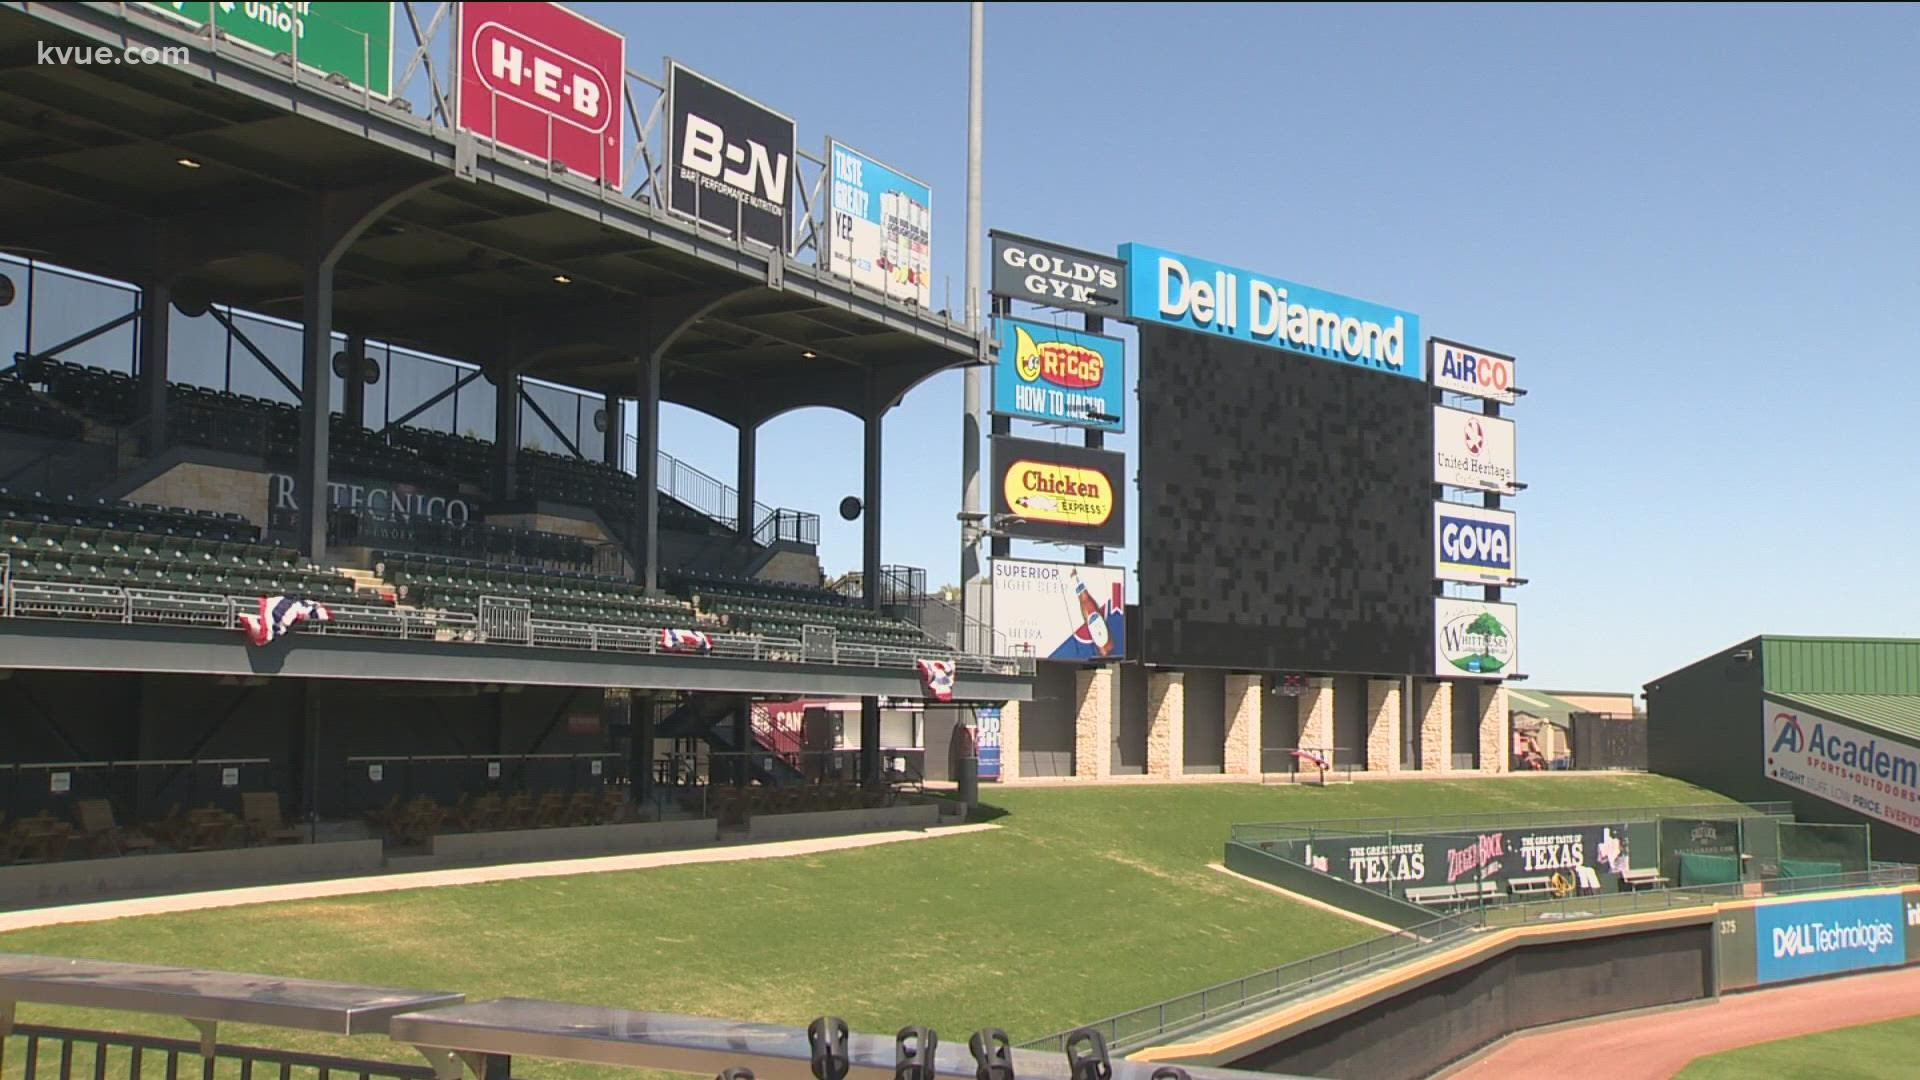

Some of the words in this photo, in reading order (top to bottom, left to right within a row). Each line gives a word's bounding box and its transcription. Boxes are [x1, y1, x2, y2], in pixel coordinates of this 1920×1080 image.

[835, 150, 863, 188] TASTE
[750, 196, 783, 217] NUTRITION
[834, 180, 869, 219] GREAT?
[1003, 247, 1117, 289] GOLD'S
[1025, 274, 1097, 305] GYM
[1158, 256, 1237, 329] Dell
[1250, 278, 1404, 367] Diamond
[1015, 384, 1047, 413] HOW
[1048, 389, 1064, 417] TO
[1437, 451, 1469, 471] United
[1471, 457, 1511, 482] Heritage
[1022, 469, 1100, 499] Chicken
[1062, 501, 1102, 515] EXPRESS
[1442, 522, 1509, 563] GOYA
[996, 563, 1060, 581] SUPERIOR
[1808, 723, 1920, 789] Academ
[1349, 853, 1425, 884] TEXAS
[1520, 843, 1584, 872] TEXAS
[1720, 920, 1737, 935] 375
